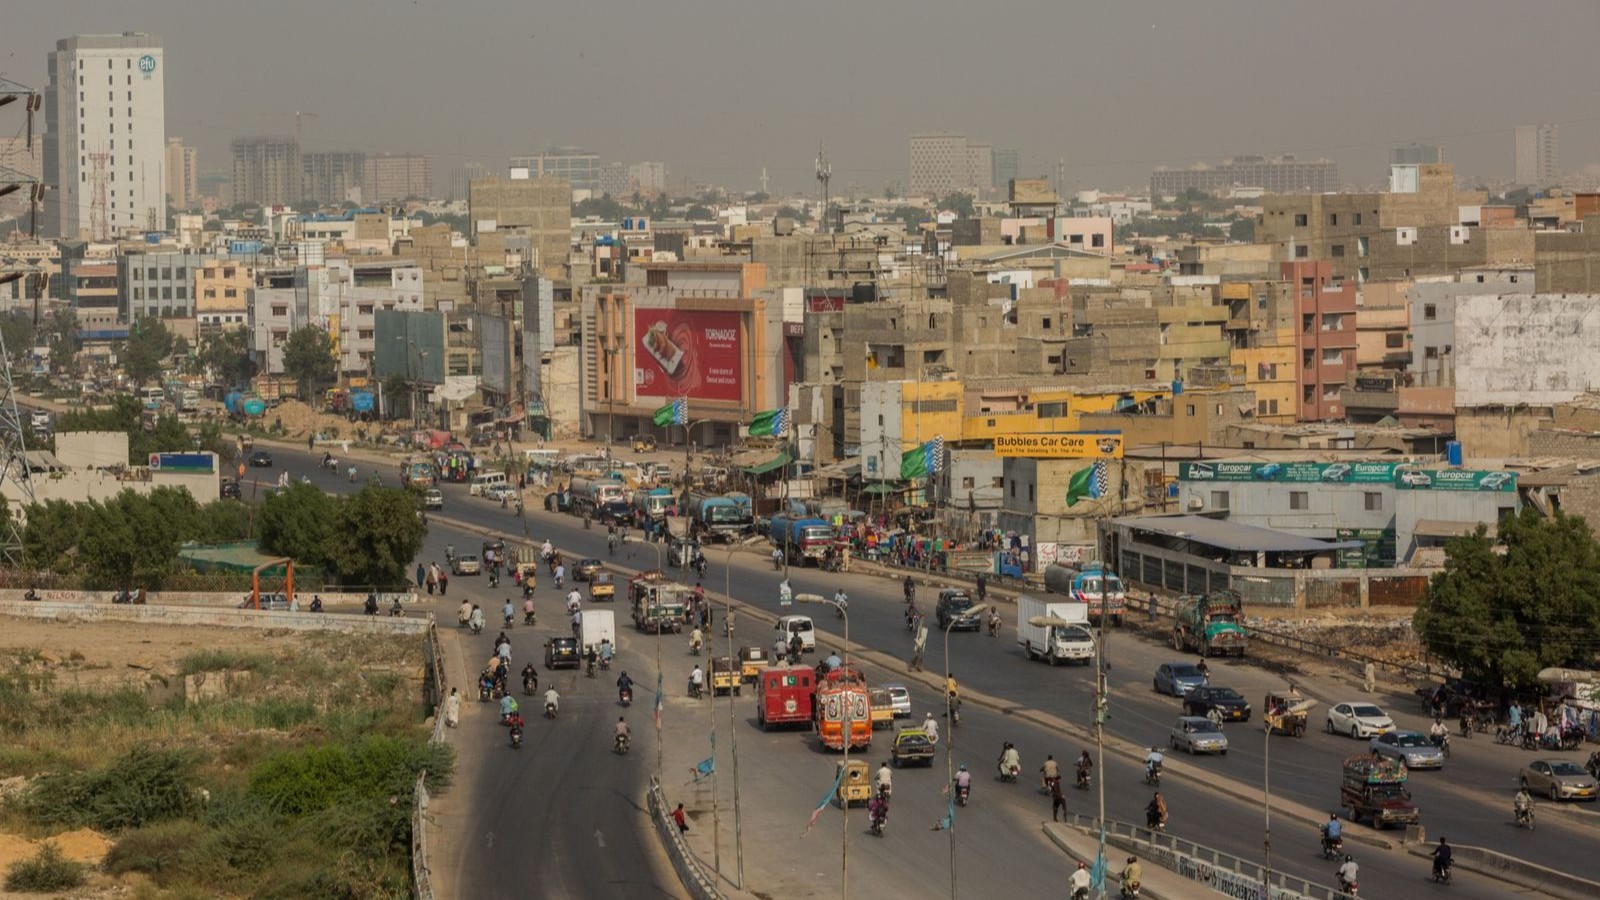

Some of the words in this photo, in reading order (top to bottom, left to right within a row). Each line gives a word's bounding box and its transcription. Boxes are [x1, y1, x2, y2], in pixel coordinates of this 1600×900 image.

[141, 57, 154, 71] efu
[705, 328, 737, 341] TORNADOZ
[997, 437, 1038, 447] Bubbles
[1040, 437, 1058, 447] Car
[1060, 437, 1085, 447] Care
[1217, 463, 1252, 473] Europcar
[1354, 463, 1390, 473] Europcar
[1436, 470, 1476, 480] Europcar
